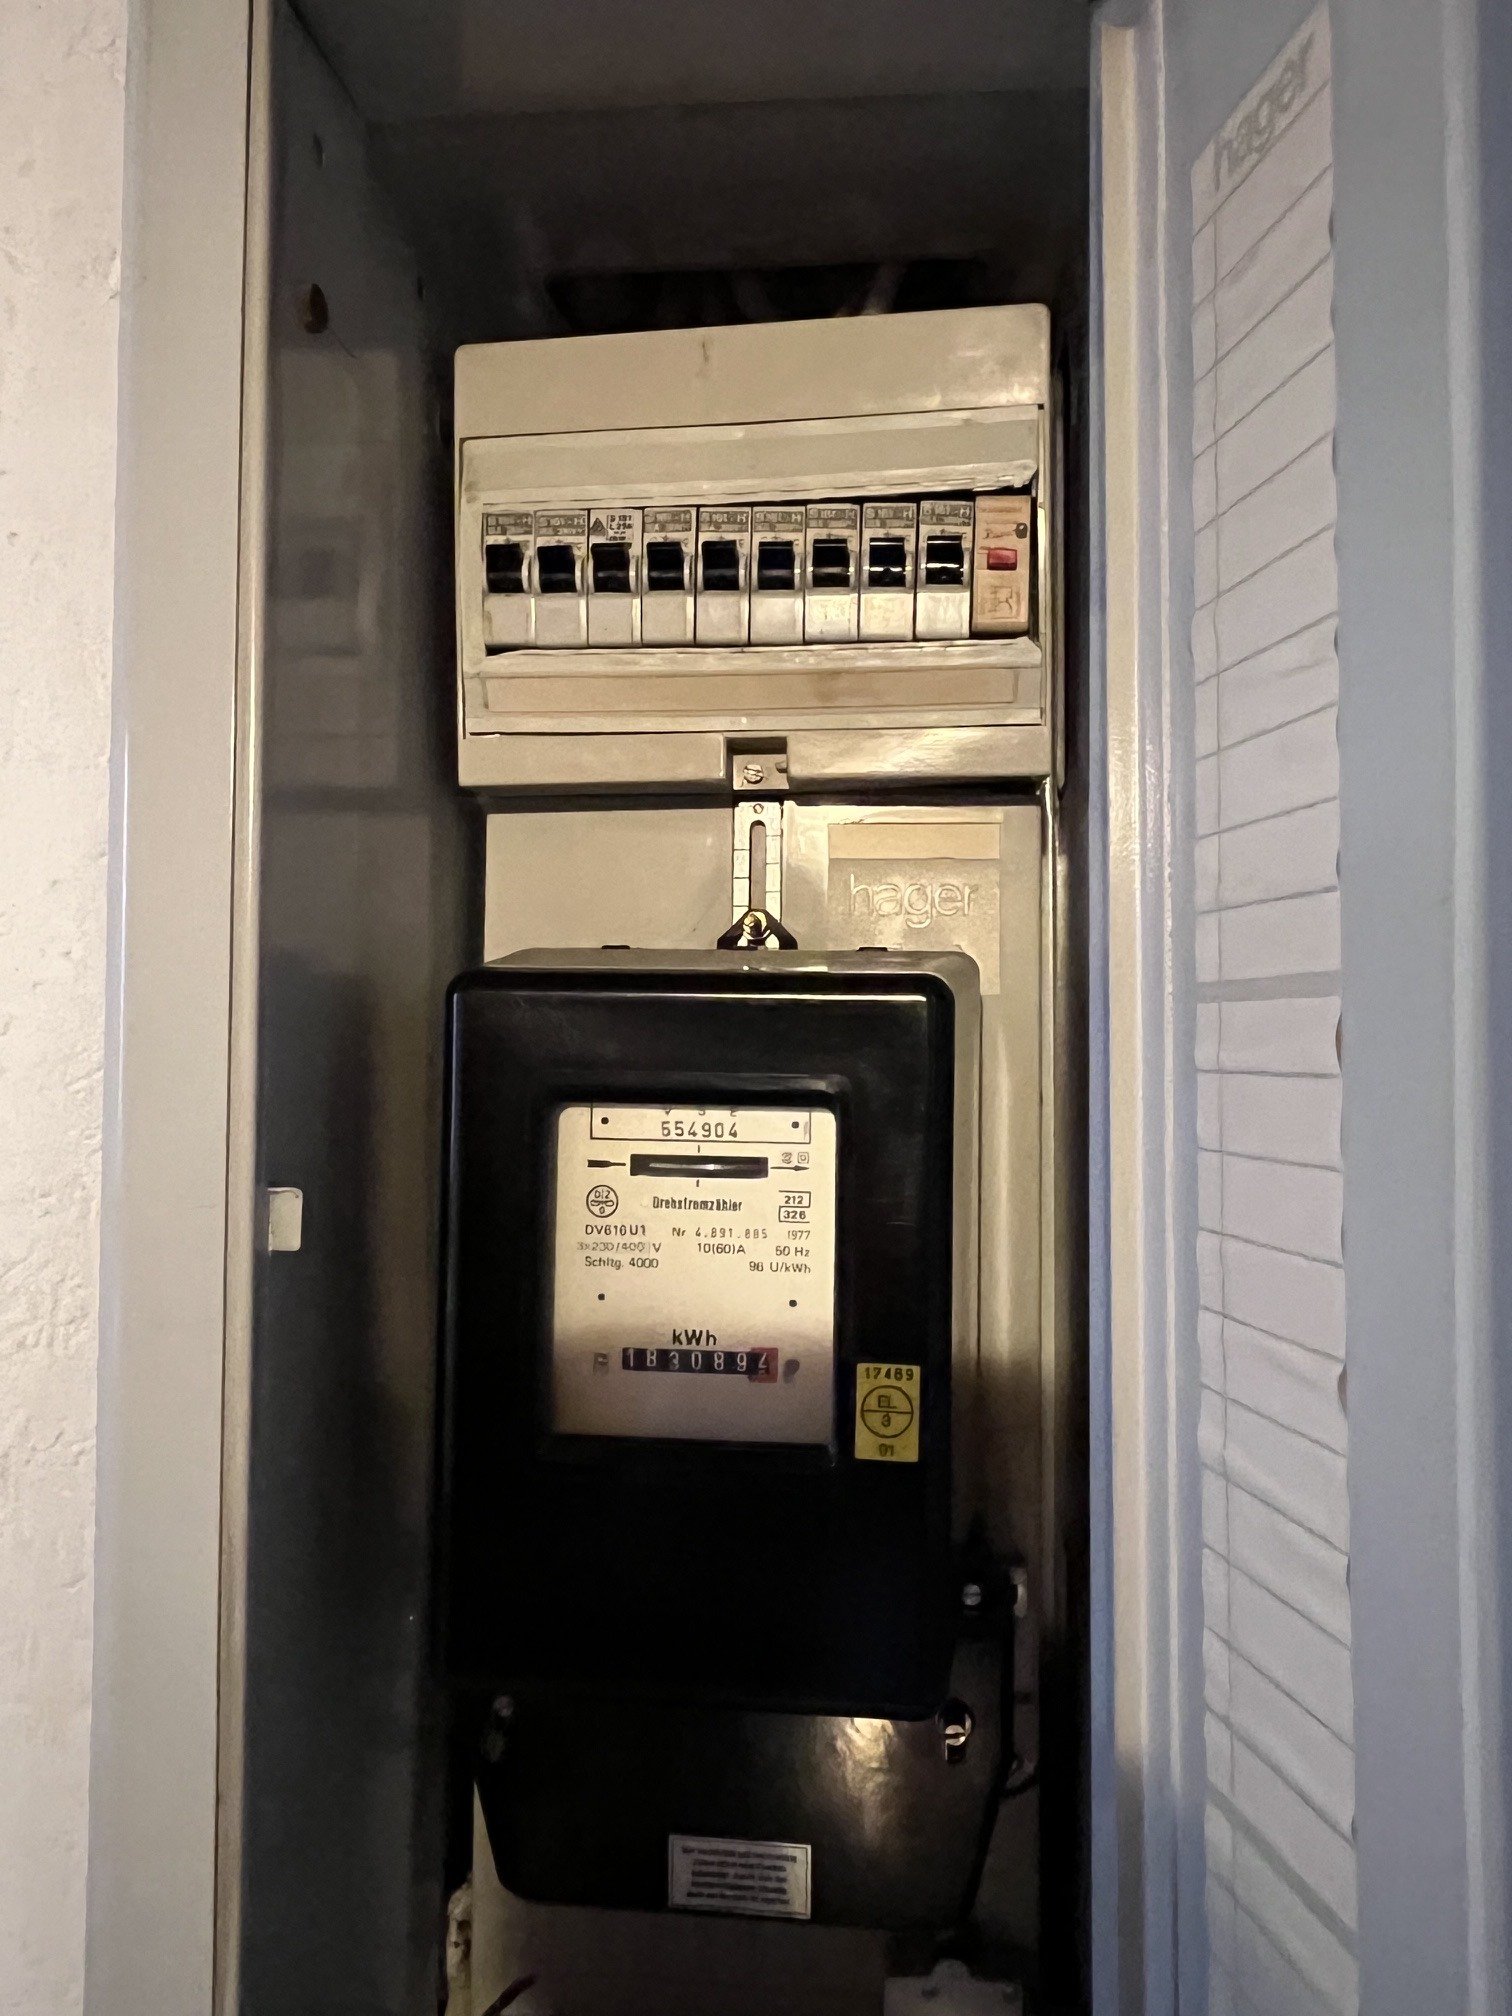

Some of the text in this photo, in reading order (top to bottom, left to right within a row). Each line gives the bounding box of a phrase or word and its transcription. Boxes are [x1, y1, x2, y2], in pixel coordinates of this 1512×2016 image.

[1213, 31, 1314, 192] hager
[850, 873, 978, 928] hager
[784, 1195, 804, 1205] 212
[783, 1209, 807, 1220] 326
[672, 1227, 686, 1237] Nr
[787, 1229, 811, 1240] 1977
[652, 1242, 661, 1253] V
[697, 1242, 747, 1255] 10(60)A
[794, 1246, 810, 1257] Hz
[629, 1257, 659, 1269] 4000
[769, 1261, 811, 1274] U/kWh
[672, 1328, 717, 1346] kWh
